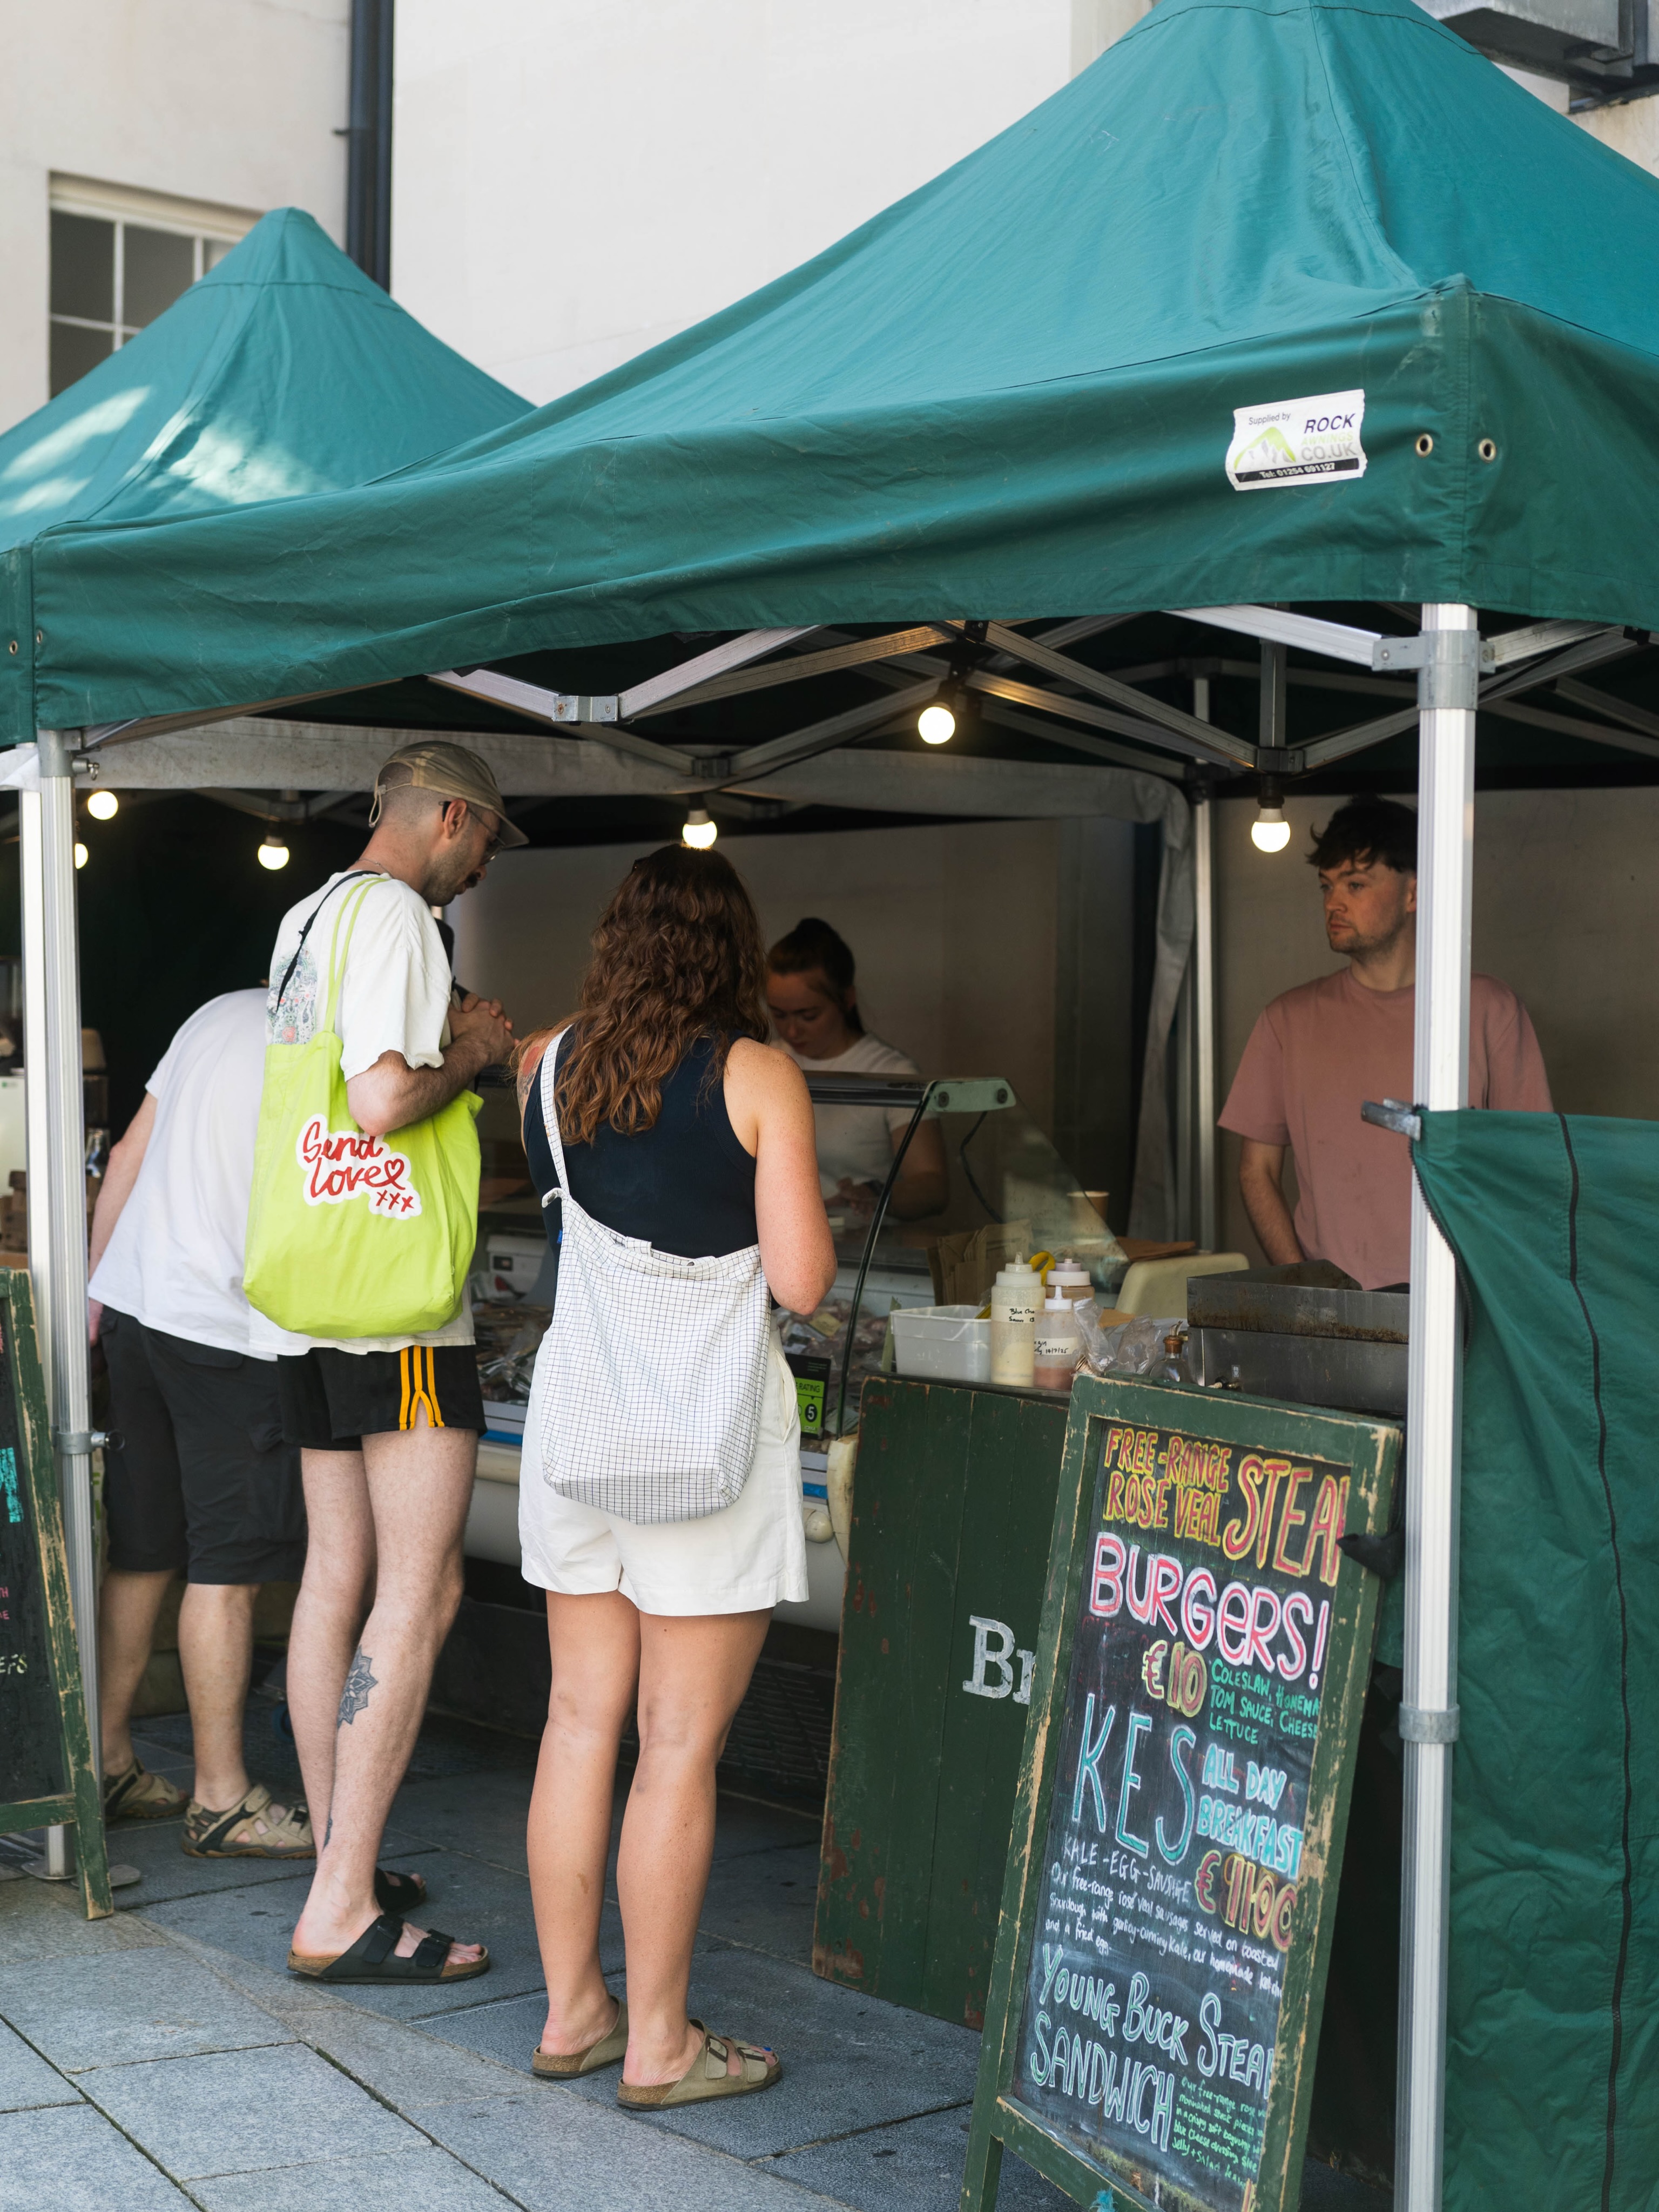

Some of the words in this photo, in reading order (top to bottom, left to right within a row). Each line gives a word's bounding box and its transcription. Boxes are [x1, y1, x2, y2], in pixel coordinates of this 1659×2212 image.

[1249, 413, 1280, 426] Supplied
[1282, 413, 1291, 421] by
[1304, 413, 1355, 434] ROCK
[1301, 432, 1353, 446] AWNINGS
[1277, 467, 1304, 477] 01254
[303, 1122, 383, 1163] Send
[311, 1157, 392, 1198] Love
[799, 1382, 820, 1393] RATING
[807, 1406, 814, 1420] 5
[1103, 1471, 1171, 1529] ROSE
[1175, 1486, 1222, 1547] VEAL
[1210, 1684, 1235, 1715] TOM
[1209, 1712, 1258, 1744] LETTUCE
[1071, 1692, 1196, 1865] KES
[1202, 1743, 1239, 1794] ALL
[1246, 1761, 1287, 1810] DAY
[1197, 1795, 1304, 1879] BREAKFAST
[1046, 1918, 1060, 1932] and
[1064, 1924, 1070, 1934] a
[1075, 1921, 1094, 1942] fried
[1051, 1862, 1068, 1887] Our
[1138, 1897, 1153, 1917] veal
[1194, 1922, 1223, 1947] served
[1226, 1939, 1237, 1951] on
[1242, 1942, 1280, 1971] toasted
[1092, 1906, 1108, 1923] with
[1193, 1949, 1206, 1964] our
[1030, 2011, 1174, 2152] SANDWICH
